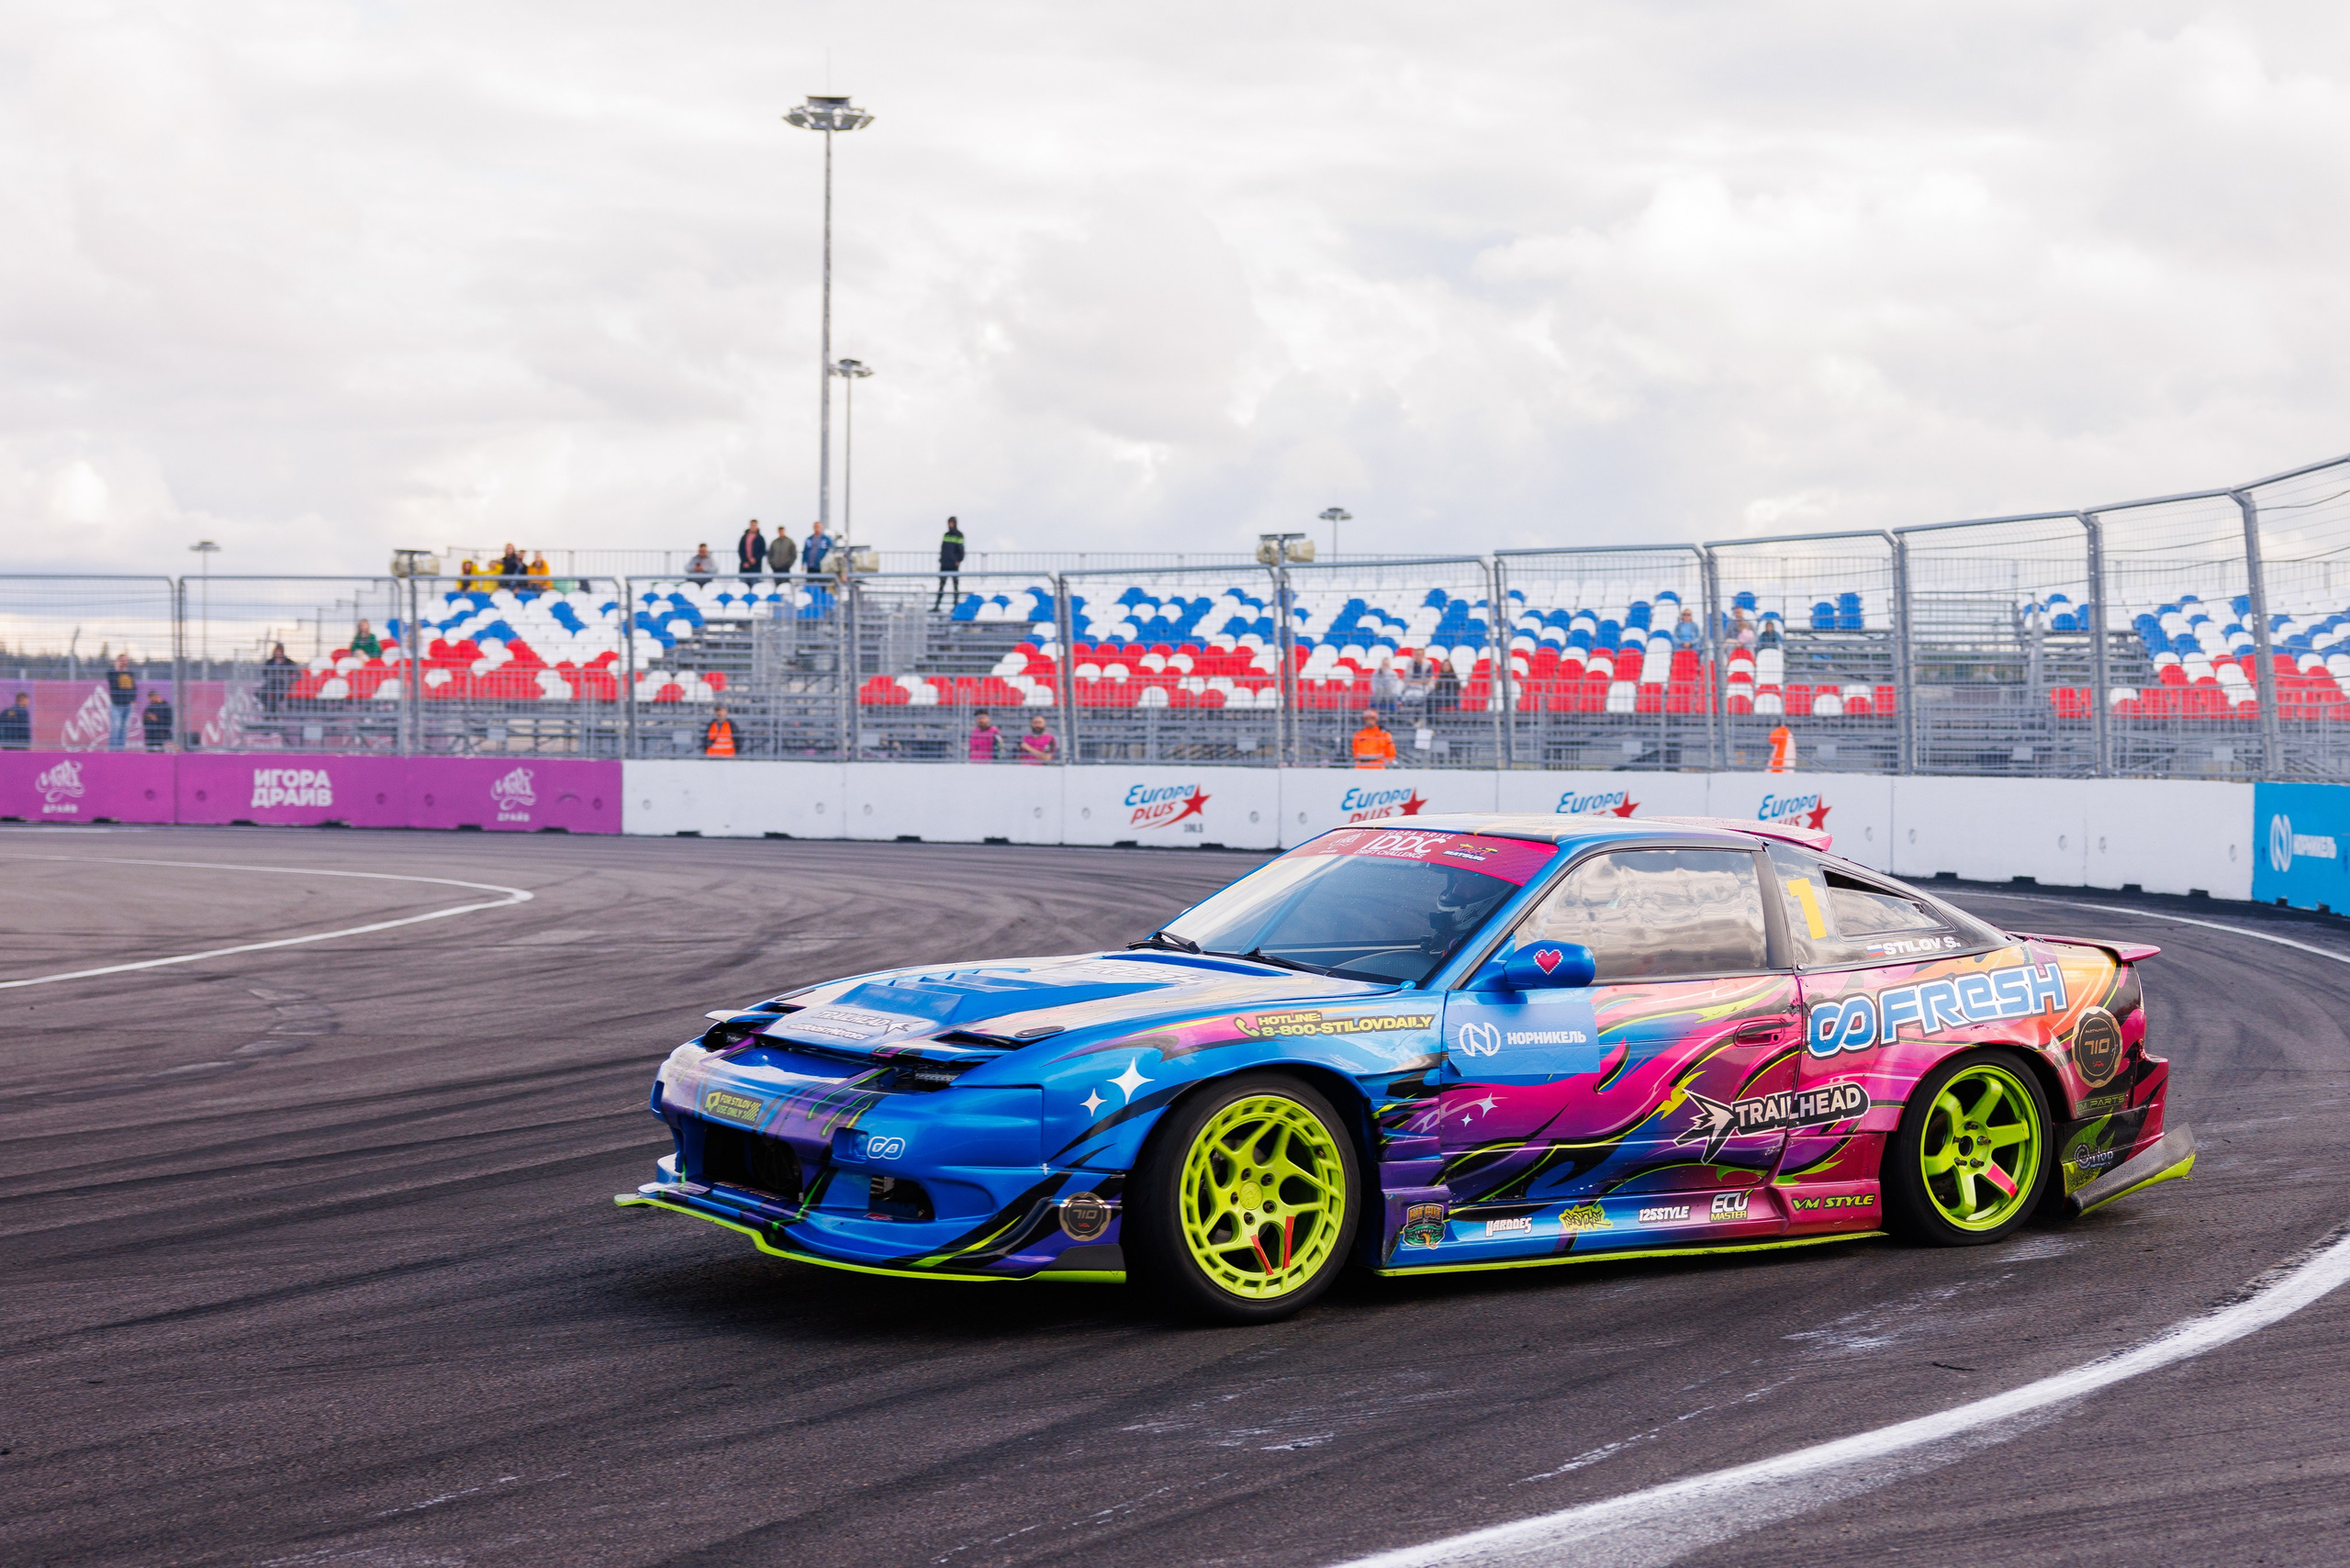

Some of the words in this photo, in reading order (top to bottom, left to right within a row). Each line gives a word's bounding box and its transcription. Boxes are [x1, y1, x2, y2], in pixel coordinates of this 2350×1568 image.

[254, 768, 331, 788] ИГОРА
[251, 788, 332, 808] ДРАЙВ
[1125, 784, 1195, 806] Europa
[1341, 788, 1412, 811] Europa
[1758, 794, 1818, 821] Europa
[1360, 834, 1447, 854] IDDC
[1377, 850, 1427, 859] CHALLENGE
[1786, 878, 1828, 940] 1
[1883, 937, 1941, 956] STILOV
[1942, 936, 1961, 949] S.
[813, 1010, 892, 1026] TRAILHEAD
[1258, 1013, 1322, 1026] HOTLINE:
[1261, 1015, 1433, 1036] 8-800-STILOVDAILY
[1507, 1031, 1587, 1045] НОРНИКЕЛЬ
[2085, 1038, 2110, 1055] 710
[1735, 1087, 1863, 1127] TRAILHEAD
[2090, 1095, 2125, 1107] PARTS
[1711, 1190, 1752, 1213] ECU
[1792, 1198, 1820, 1209] VM
[1825, 1194, 1875, 1207] STYLE
[1072, 1209, 1099, 1219] 710
[1639, 1205, 1690, 1222] 125STYLE
[1710, 1211, 1748, 1221] MASTER
